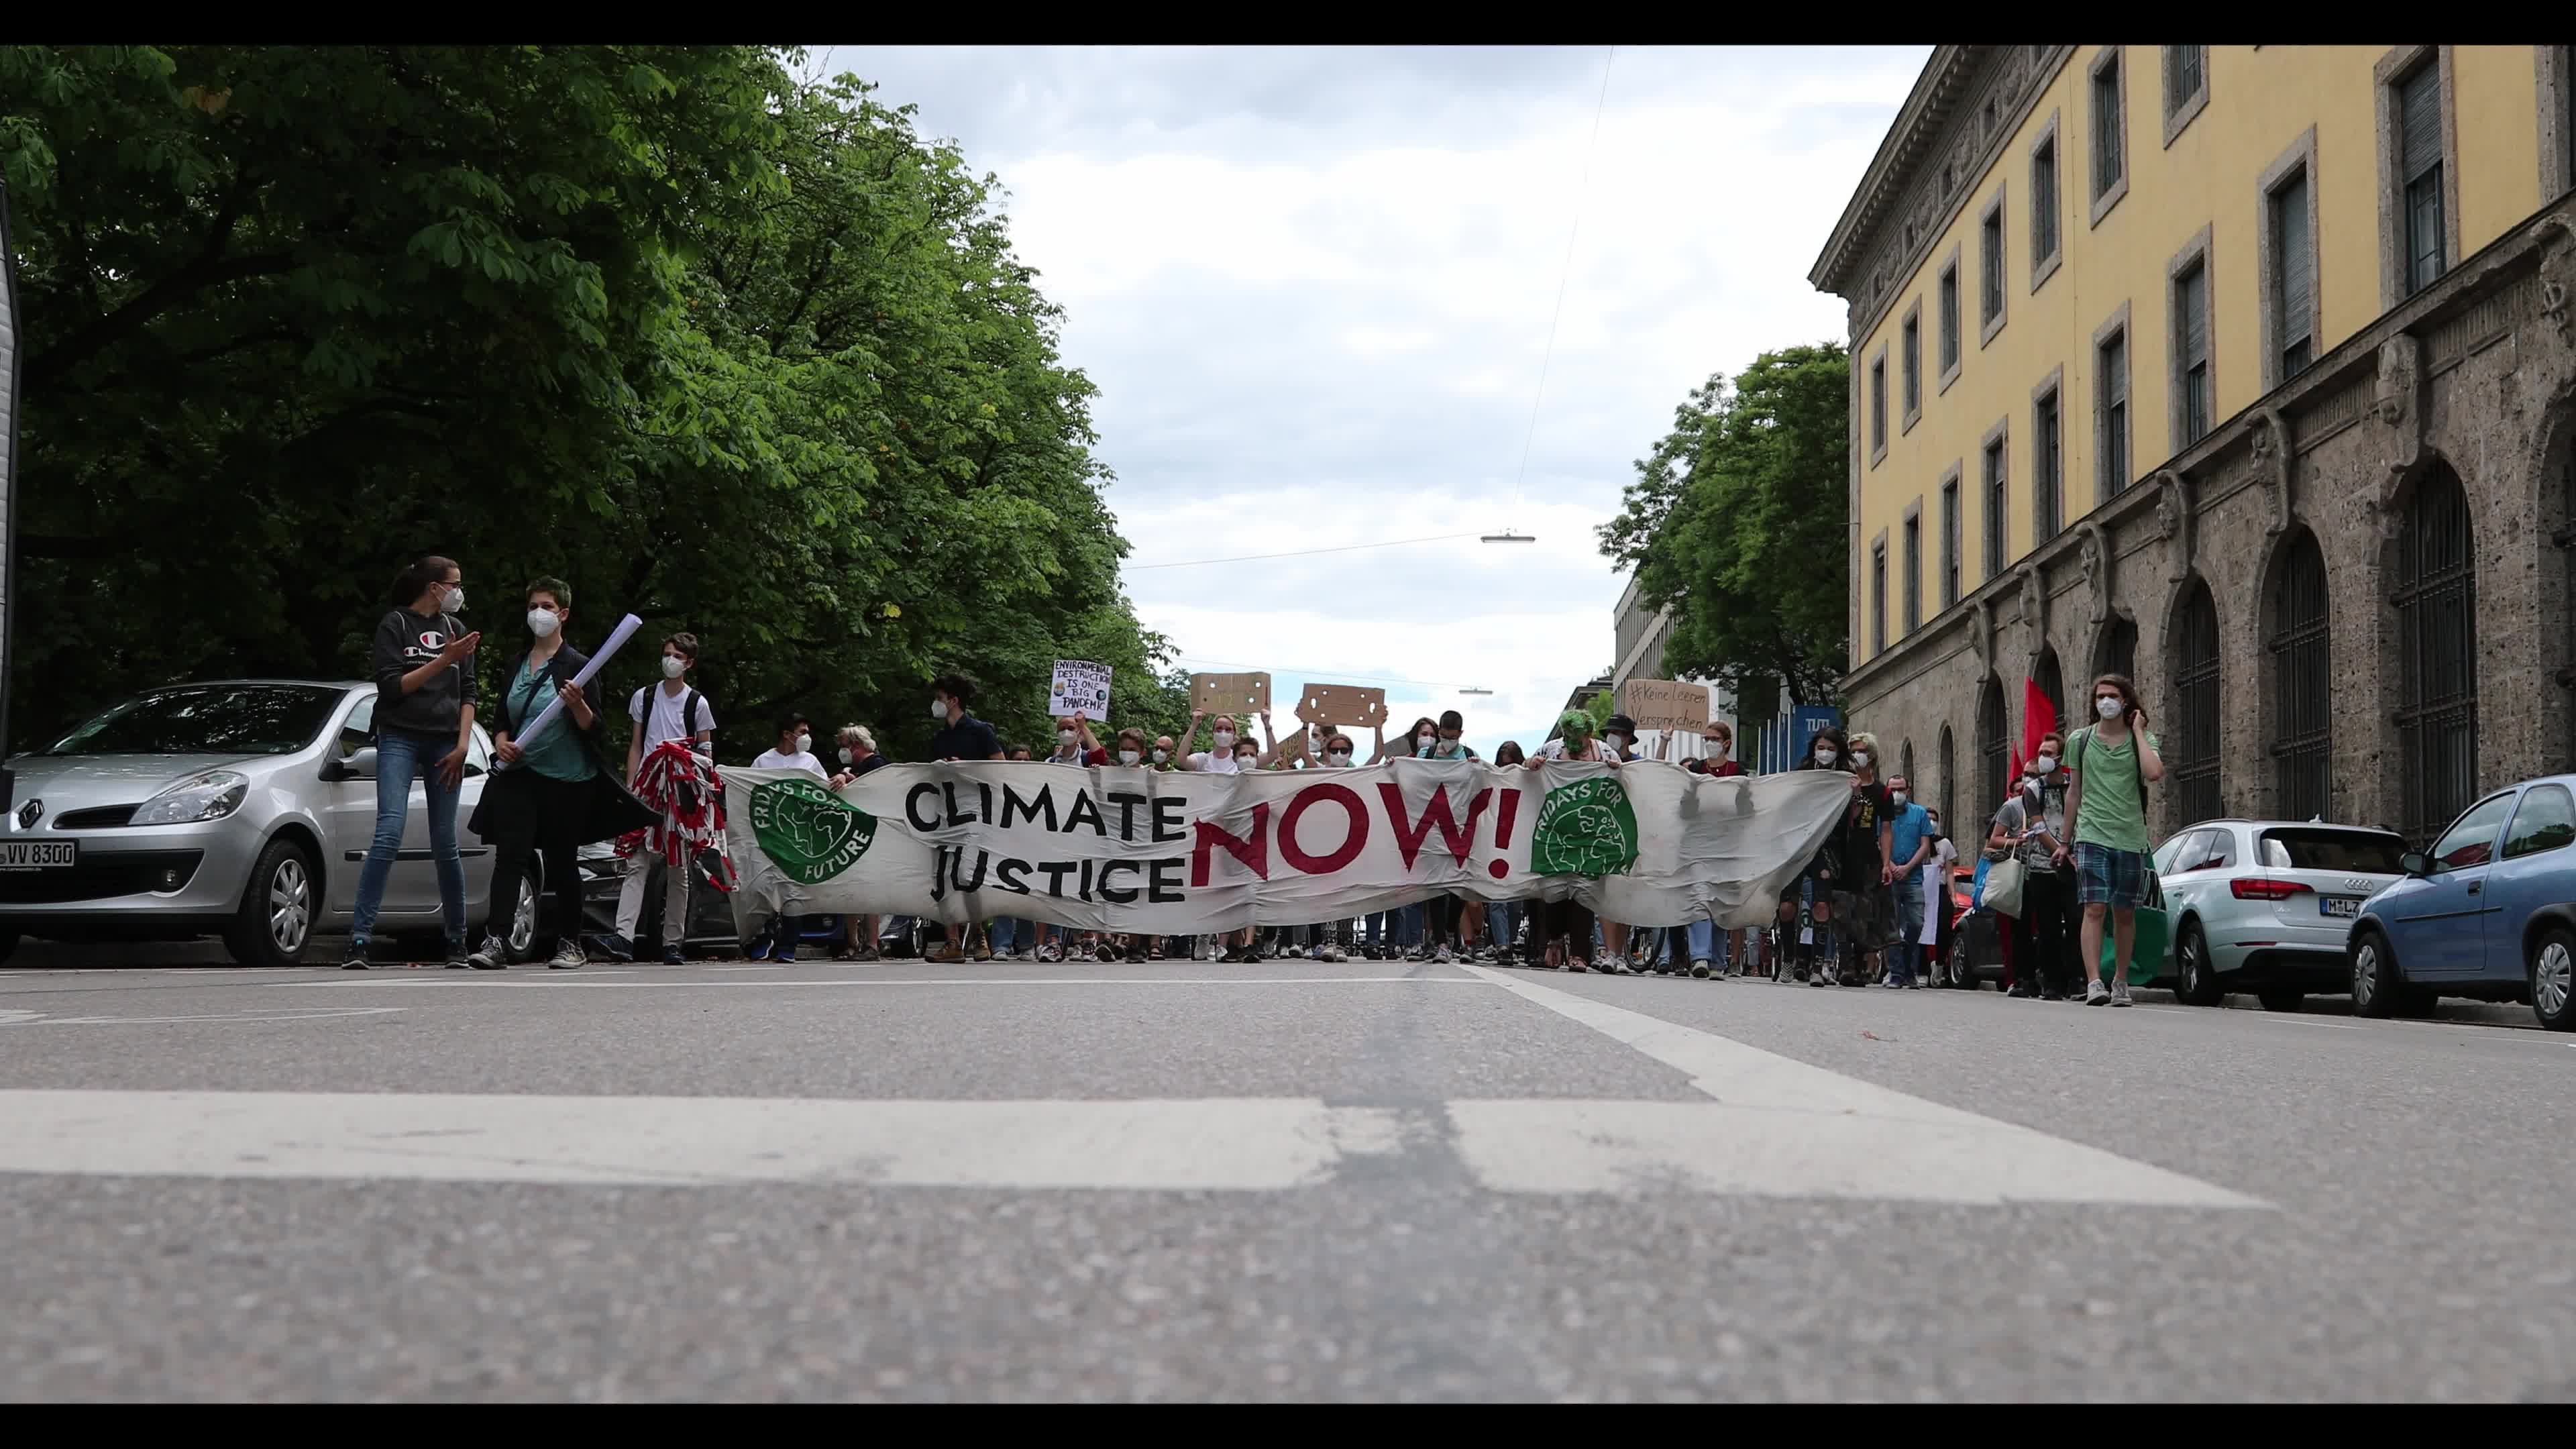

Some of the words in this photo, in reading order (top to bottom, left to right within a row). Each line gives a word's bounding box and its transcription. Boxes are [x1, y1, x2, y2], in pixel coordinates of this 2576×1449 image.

[1057, 670, 1111, 684] DESTRUCTION
[1067, 679, 1078, 688] IS
[1081, 681, 1099, 690] ONE
[1072, 688, 1089, 697] BIG
[1063, 697, 1106, 711] PANDEMIC
[801, 784, 841, 809] FOR
[1597, 782, 1623, 808] FOR
[905, 782, 1187, 843] CLIMATE
[1191, 782, 1521, 887] NOW!
[7, 845, 28, 864] VV
[32, 845, 72, 864] 8300
[805, 829, 871, 879] FUTURE
[930, 845, 1186, 903] JUSTICE
[2328, 900, 2337, 912] M
